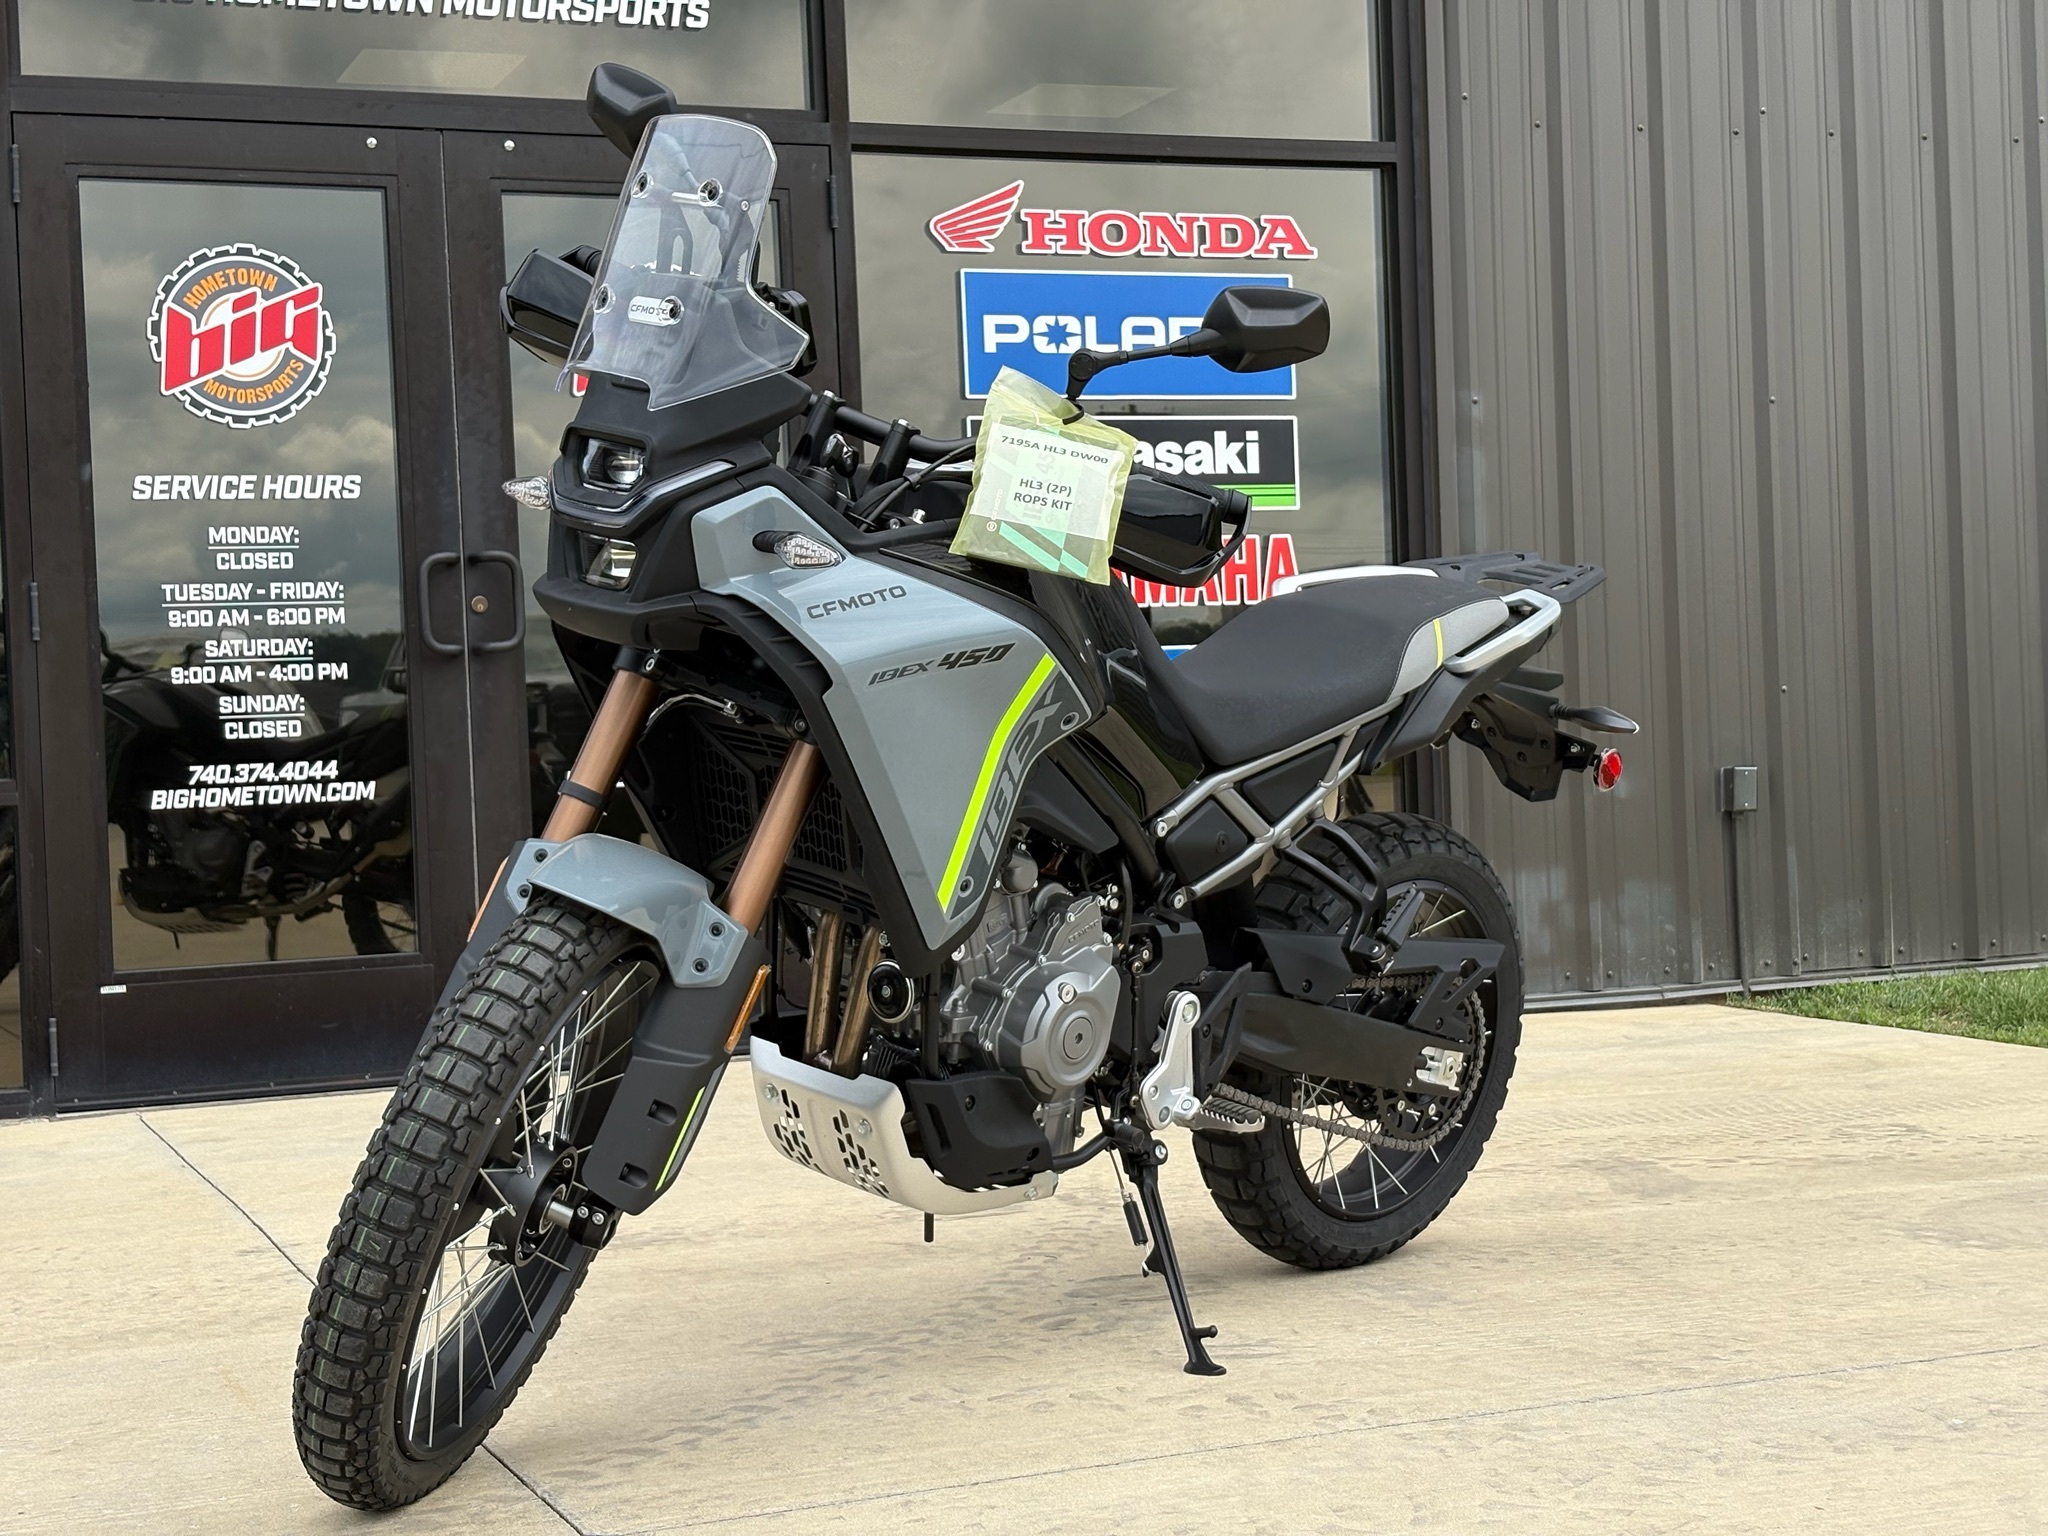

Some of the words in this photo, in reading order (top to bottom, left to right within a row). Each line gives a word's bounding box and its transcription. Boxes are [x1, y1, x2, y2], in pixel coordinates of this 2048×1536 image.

[1021, 209, 1318, 258] HONDA
[183, 267, 279, 310] HOMETOWN
[983, 314, 1205, 354] POLAR
[203, 358, 305, 404] MOTORSPORTS
[1001, 435, 1040, 450] 7195A
[1043, 444, 1067, 456] HL3
[1070, 450, 1109, 465] DW00
[1133, 430, 1260, 476] asaki
[132, 475, 257, 500] SERVICE
[260, 475, 362, 500] HOURS
[1019, 478, 1043, 490] HL3
[1046, 483, 1072, 498] (2P)
[1013, 492, 1048, 507] ROPS
[1051, 499, 1073, 511] KIT
[208, 526, 299, 545] MONDAY:
[216, 552, 294, 570] CLOSED
[161, 583, 253, 602] TUESDAY
[270, 581, 345, 600] FRIDAY:
[806, 585, 907, 620] CFMOTO
[168, 610, 214, 628] 9:00
[217, 609, 250, 627] AM
[267, 608, 311, 626] 6:00
[316, 607, 346, 625] PM
[205, 638, 314, 658] SATURDAY:
[171, 667, 216, 685] 9:00
[220, 665, 253, 684] AM
[269, 664, 314, 682] 4:00
[318, 663, 349, 681] PM
[868, 660, 936, 686] IBEX
[937, 642, 1017, 671] 450
[219, 695, 305, 714] SUNDAY:
[224, 720, 302, 739] CLOSED
[188, 760, 339, 784] 740.374.4044
[979, 680, 1063, 865] IBEX
[150, 781, 376, 810] BIGHOMETOWN.COM
